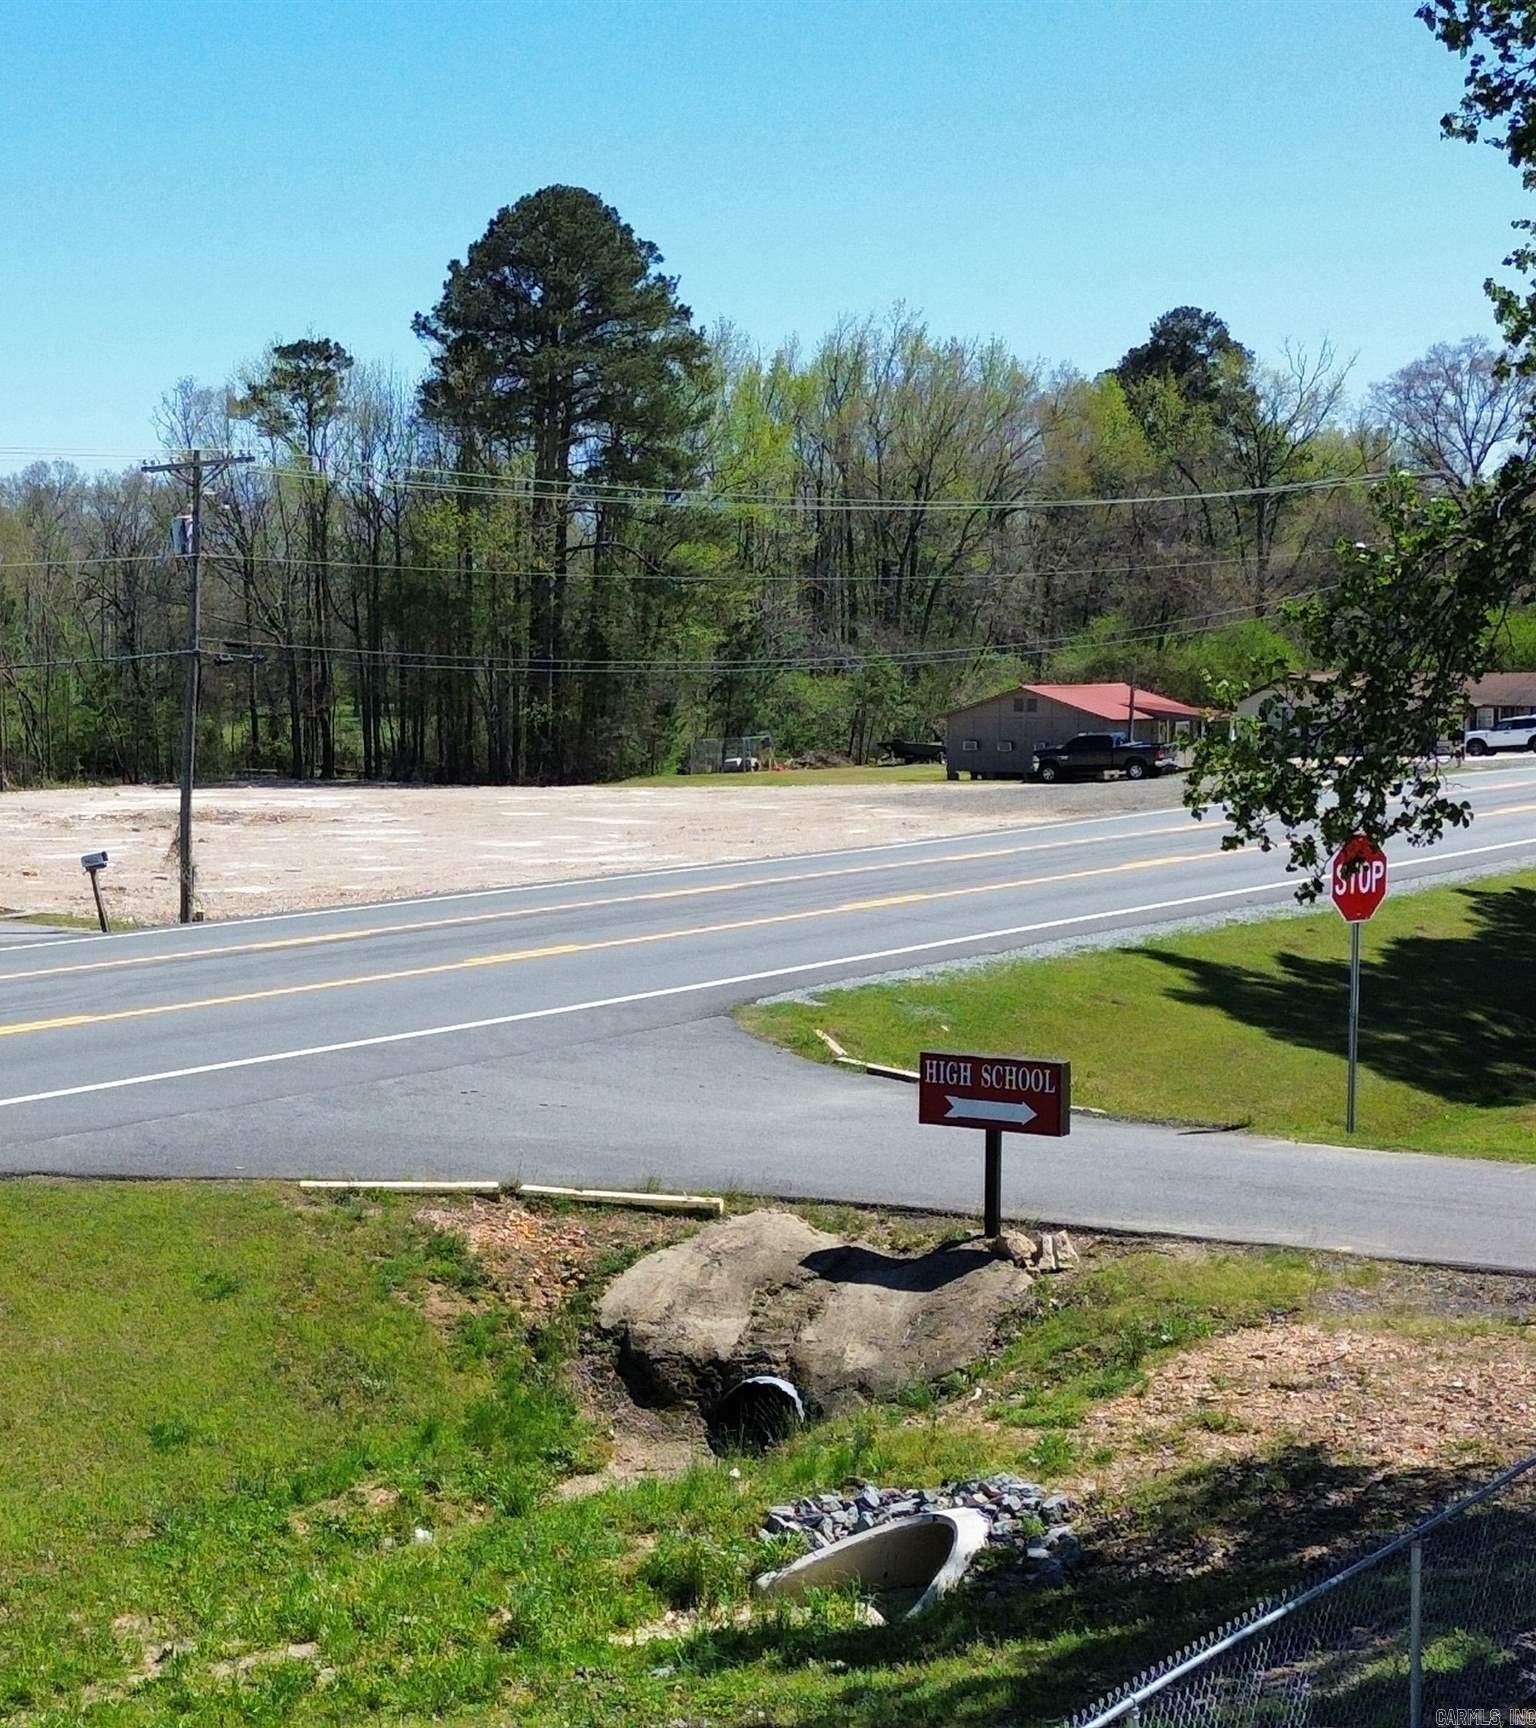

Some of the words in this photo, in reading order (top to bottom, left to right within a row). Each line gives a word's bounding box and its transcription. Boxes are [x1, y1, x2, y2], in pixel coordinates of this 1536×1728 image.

[1334, 860, 1385, 896] STOP
[924, 1059, 973, 1087] HIGH
[980, 1063, 1056, 1094] SCHOOL
